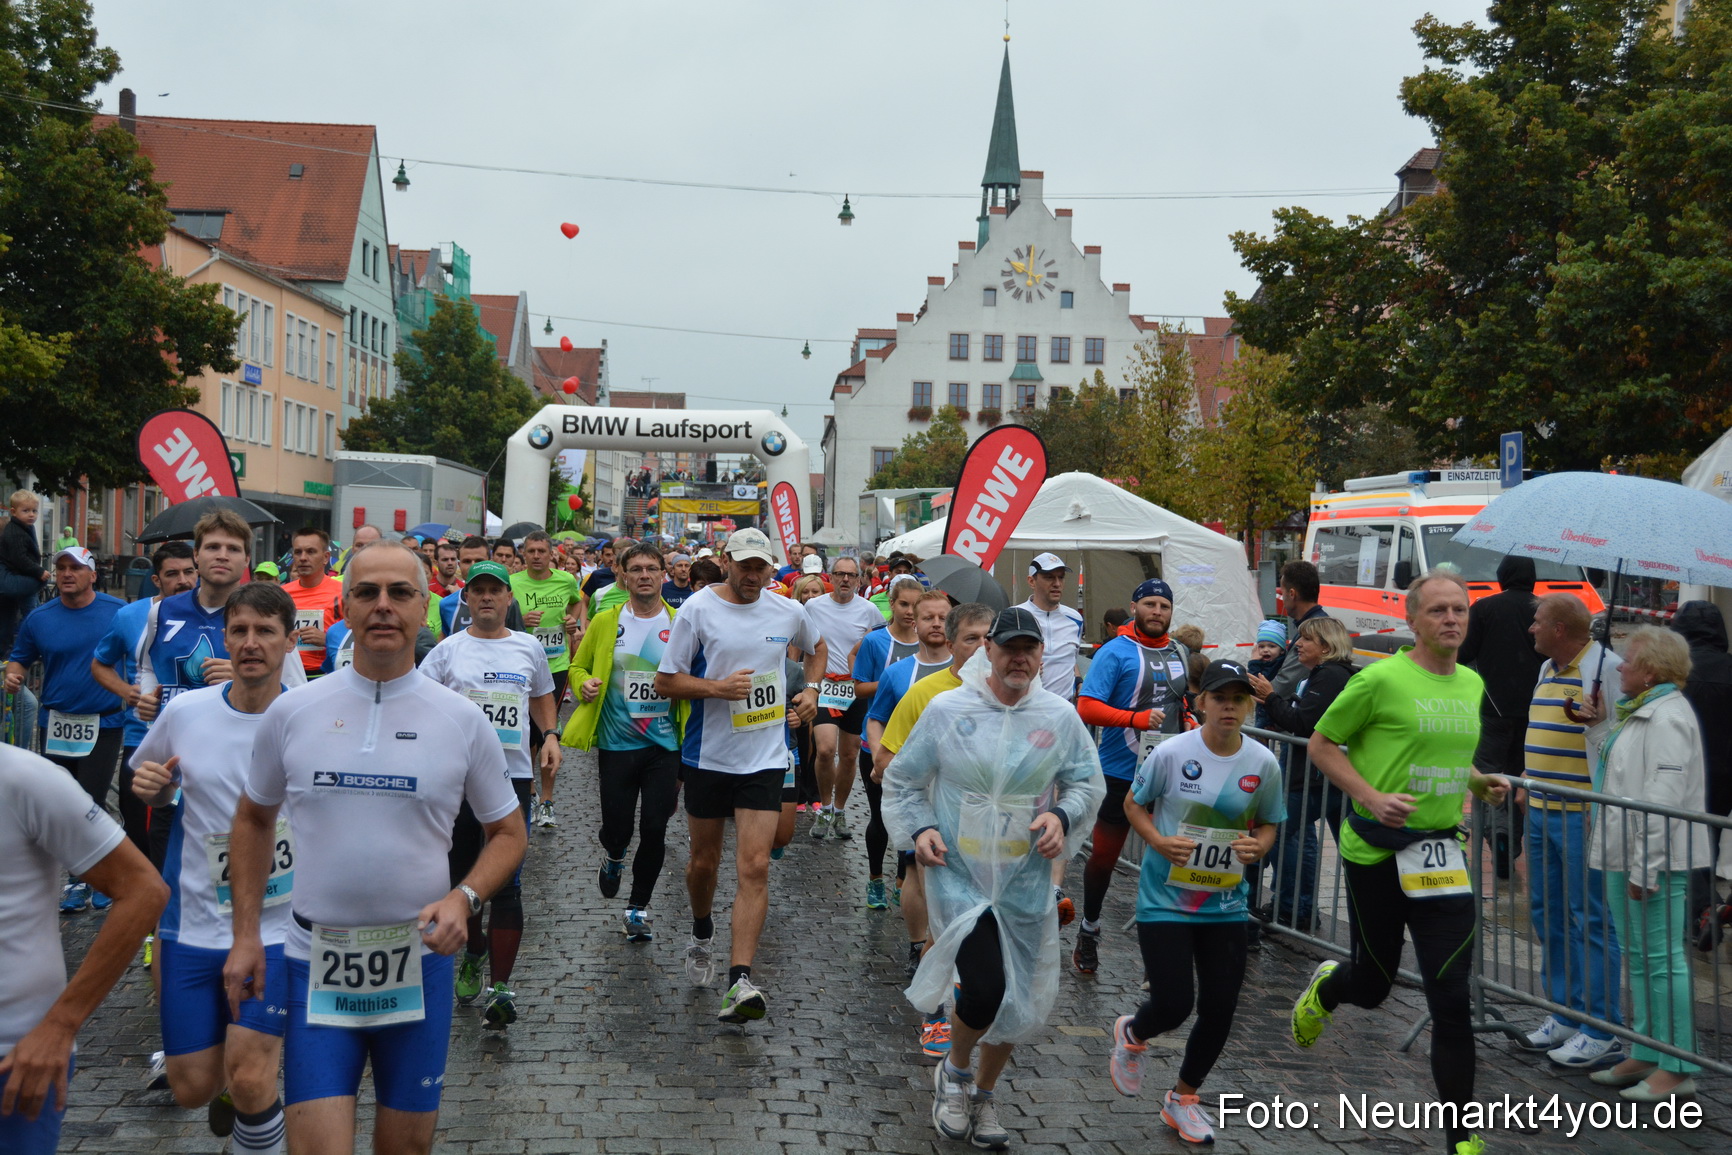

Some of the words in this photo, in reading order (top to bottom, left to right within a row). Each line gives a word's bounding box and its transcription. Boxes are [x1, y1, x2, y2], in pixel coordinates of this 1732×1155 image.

[562, 414, 629, 436] BMW
[635, 418, 752, 443] Laufsport
[1505, 440, 1518, 481] P
[699, 503, 722, 512] ZIEL
[952, 444, 1034, 567] REWE
[162, 619, 187, 642] 7
[629, 682, 669, 700] 263
[746, 685, 776, 710] 180
[823, 683, 854, 699] 2699
[476, 703, 518, 728] 543
[639, 704, 657, 712] Peter
[746, 710, 776, 724] Gerhard
[53, 721, 95, 740] 3035
[343, 775, 413, 790] BÜSCHEL
[1180, 782, 1202, 790] PARTL
[1192, 843, 1232, 870] 104
[1421, 841, 1447, 869] 20
[1189, 872, 1222, 885] Sophia
[1419, 876, 1455, 887] Thomas
[357, 925, 410, 942] BOCK
[322, 945, 411, 988] 2597
[335, 996, 398, 1012] Matthias
